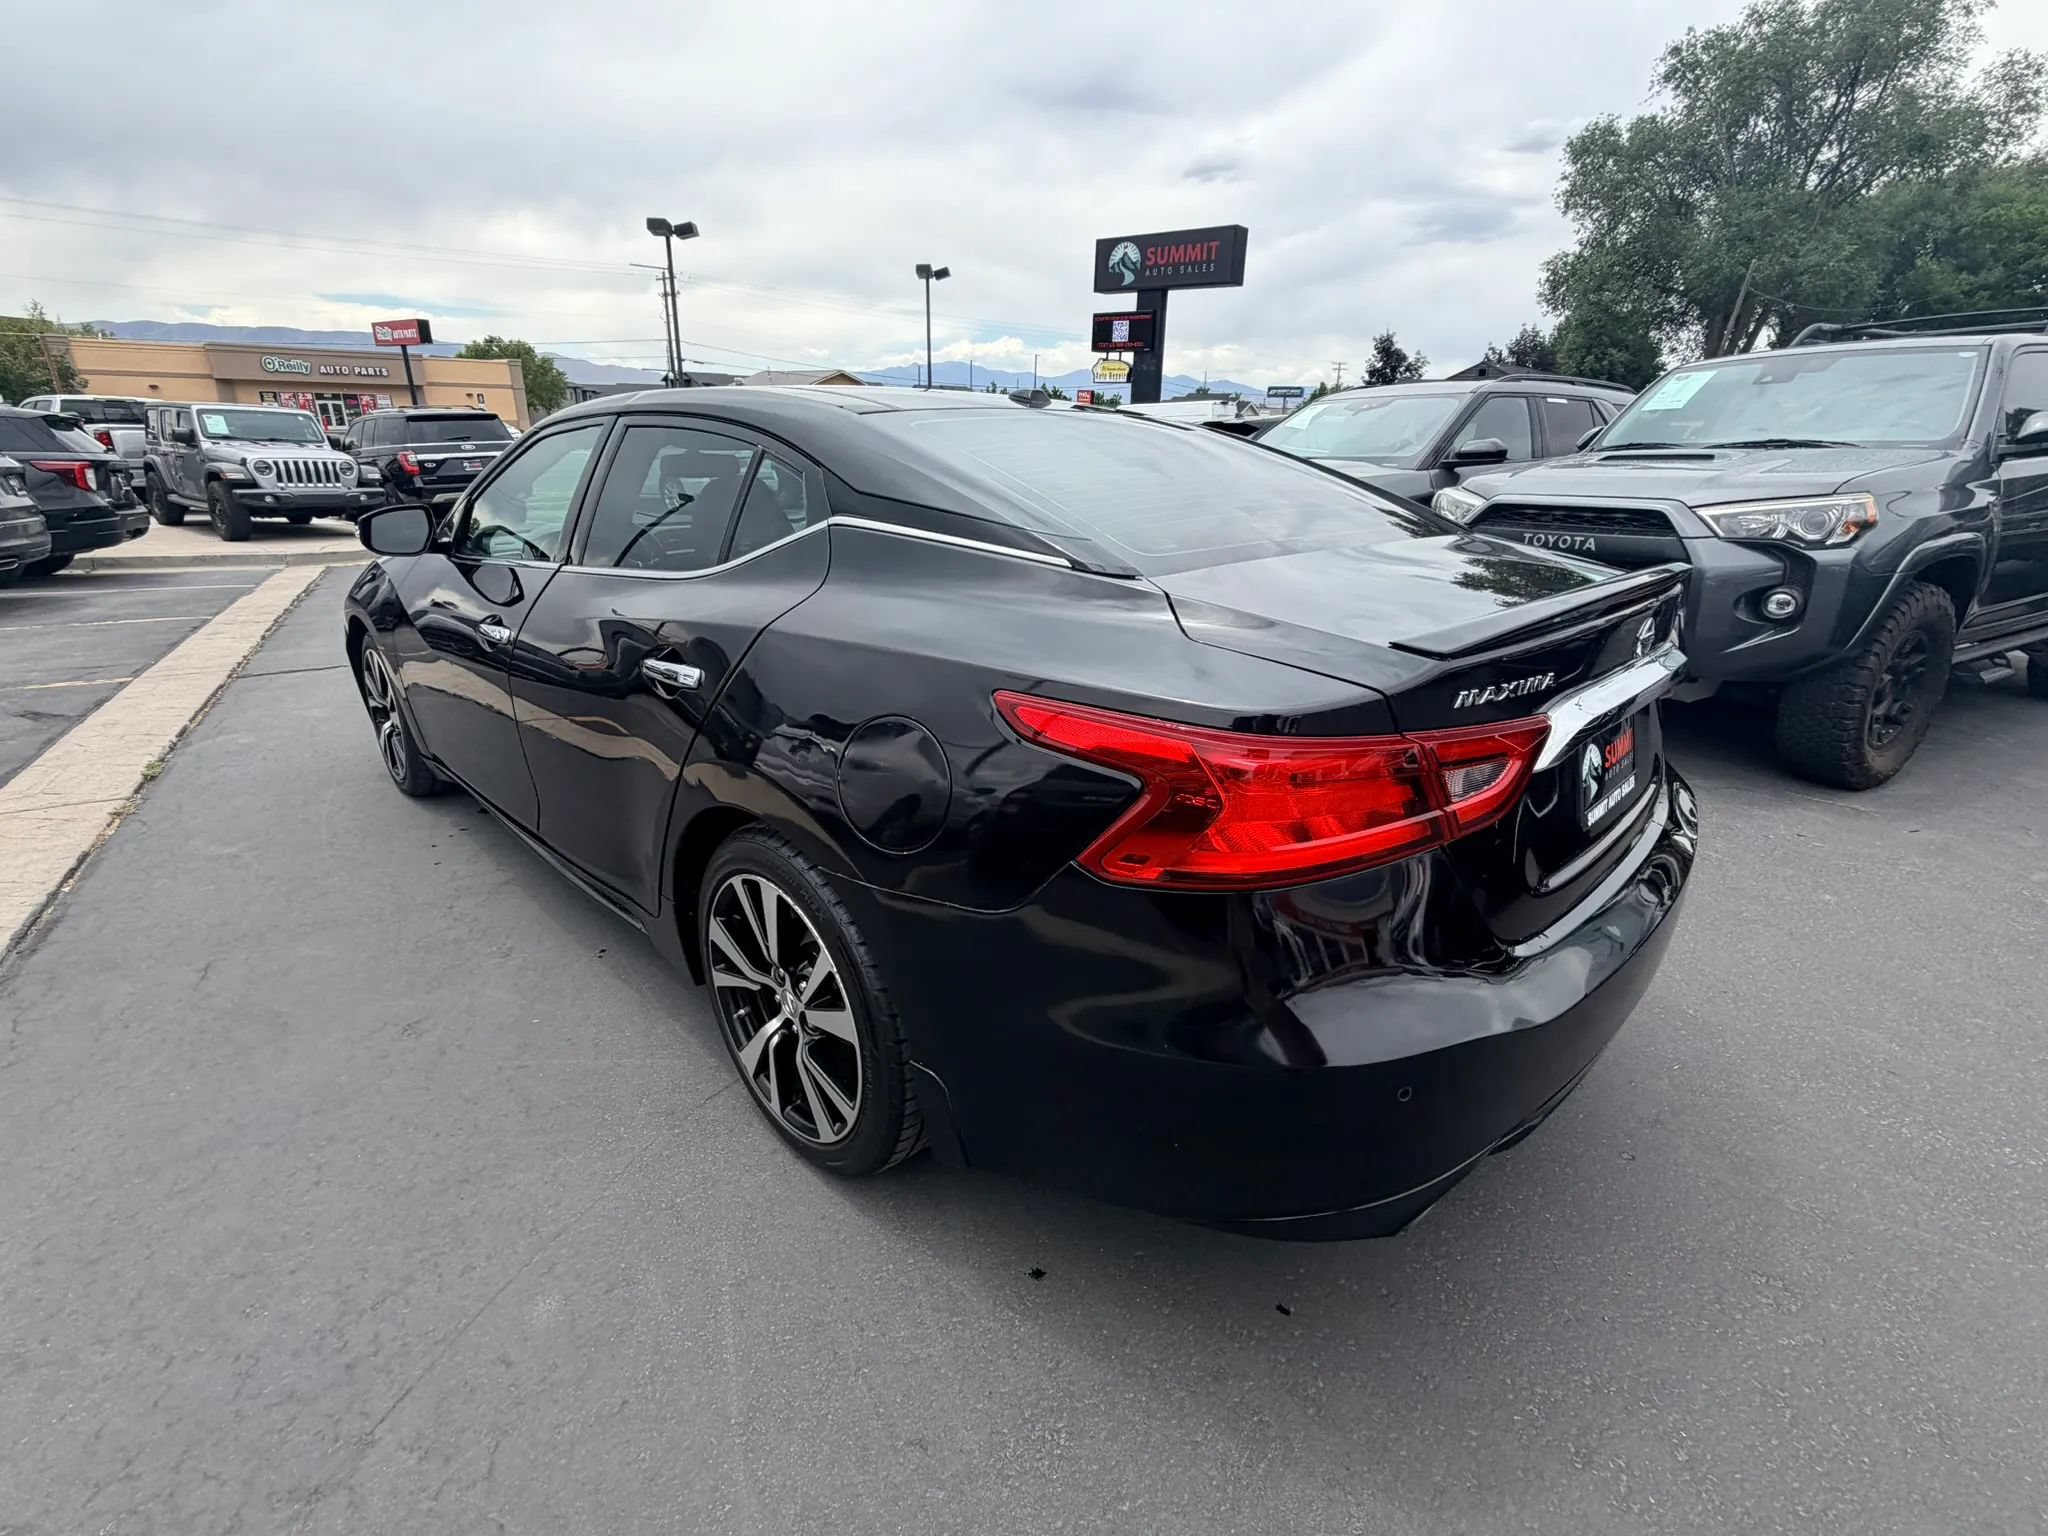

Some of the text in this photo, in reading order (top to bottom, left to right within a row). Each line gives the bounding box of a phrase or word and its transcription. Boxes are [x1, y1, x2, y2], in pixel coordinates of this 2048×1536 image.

[1145, 240, 1220, 266] SUMMIT
[1145, 263, 1215, 277] AUTO SALES
[262, 356, 388, 376] O'Reilly AUTO PARTS
[1523, 533, 1596, 551] TOYOTA
[1453, 672, 1556, 709] MAXIMA
